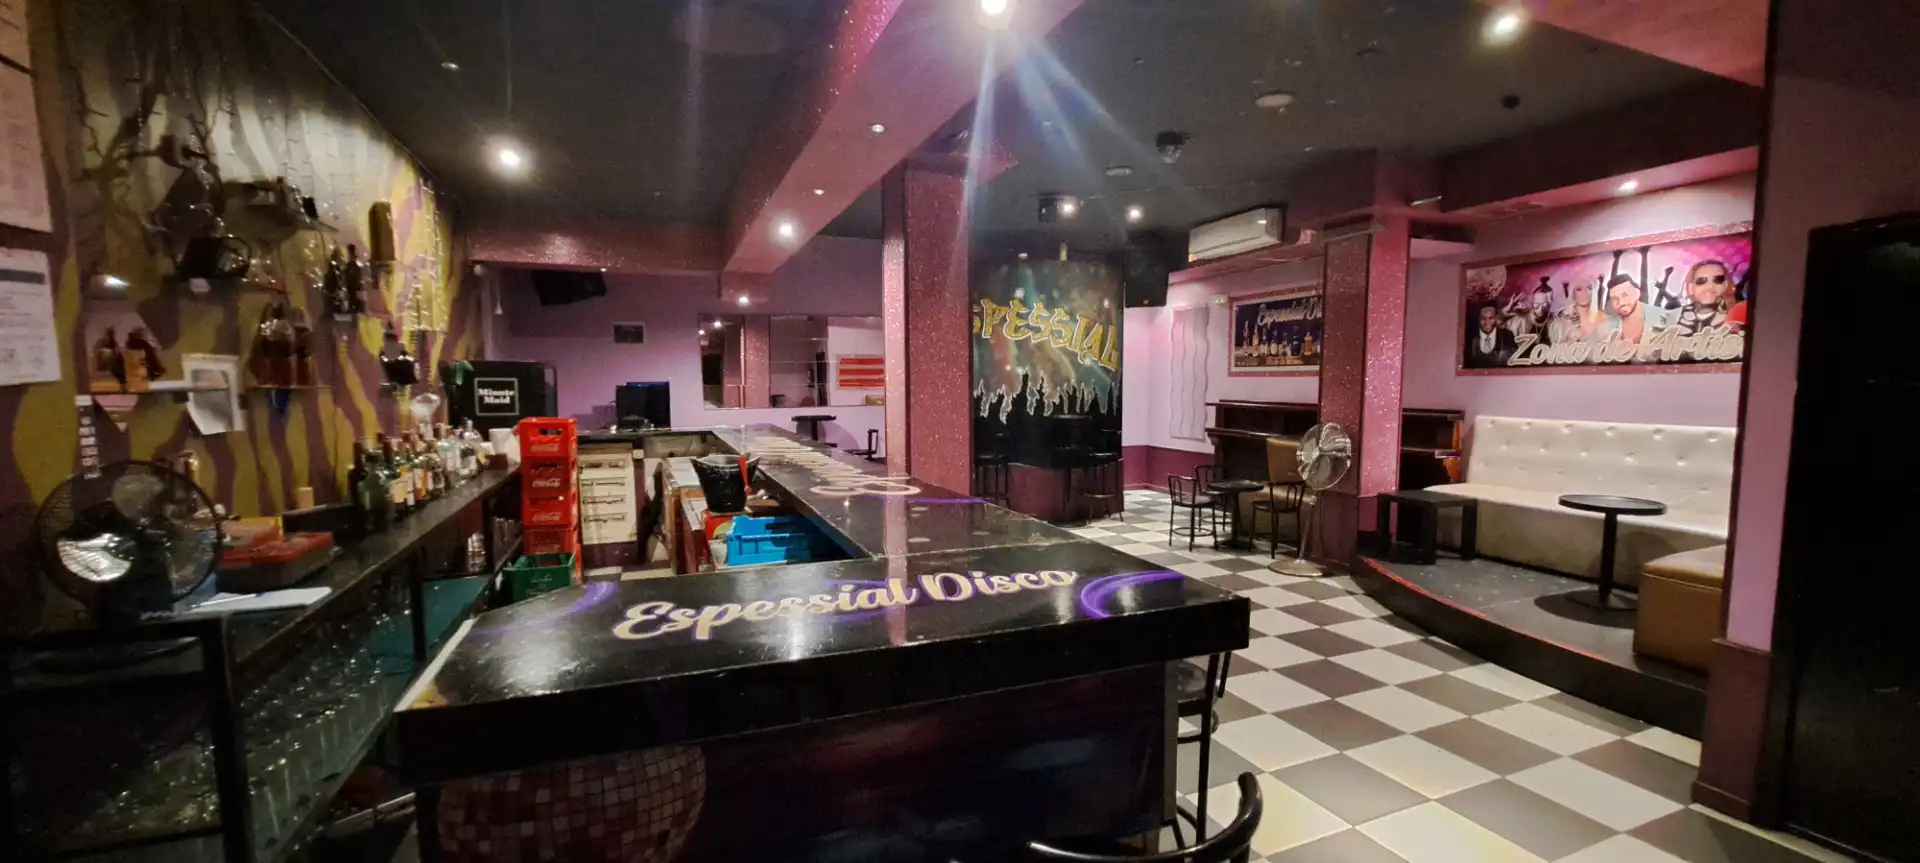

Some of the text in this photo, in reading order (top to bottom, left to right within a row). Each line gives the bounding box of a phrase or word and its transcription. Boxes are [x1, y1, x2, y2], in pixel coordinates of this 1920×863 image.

[1508, 324, 1744, 366] Zona de Artis
[483, 396, 511, 404] Maid
[612, 570, 1078, 641] Espessial Disco
